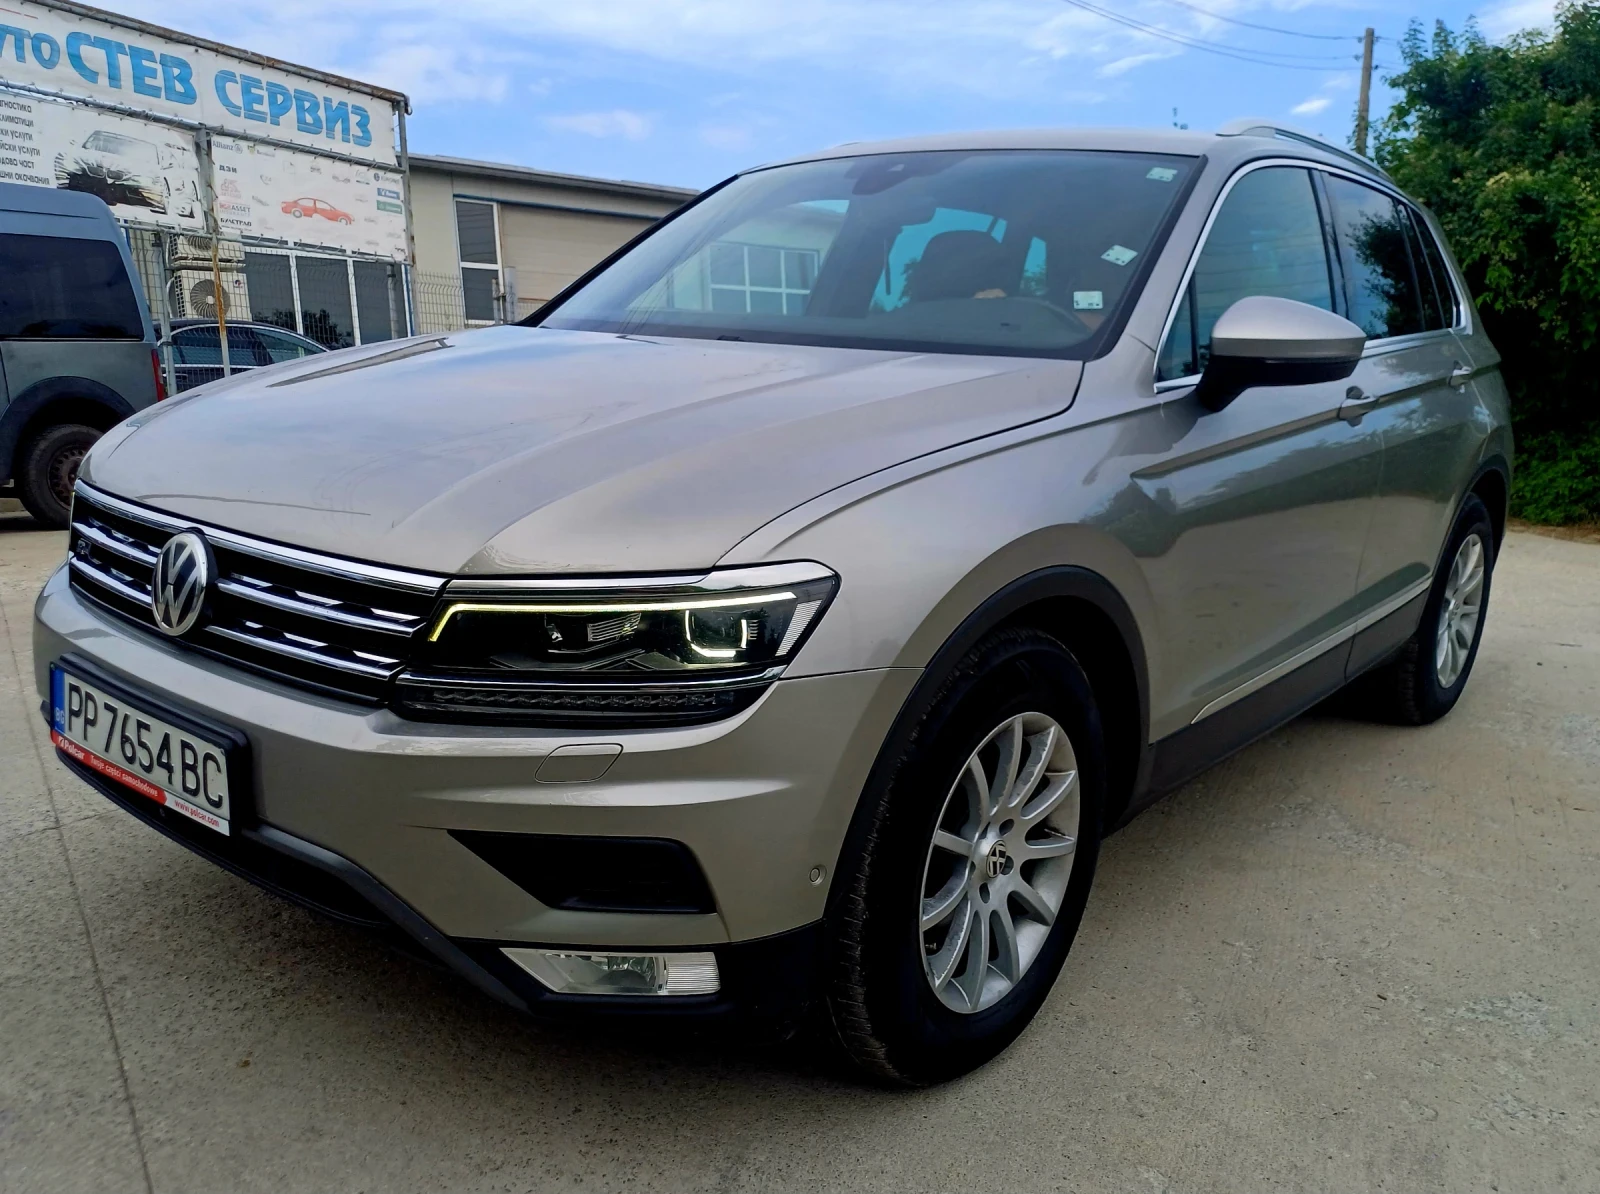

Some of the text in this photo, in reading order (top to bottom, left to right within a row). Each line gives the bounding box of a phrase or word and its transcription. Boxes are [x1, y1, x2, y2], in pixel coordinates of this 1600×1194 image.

[214, 69, 372, 147] СЕРВИЗ
[212, 140, 234, 151] Allianz
[55, 707, 65, 725] BG
[64, 740, 85, 760] Polcar
